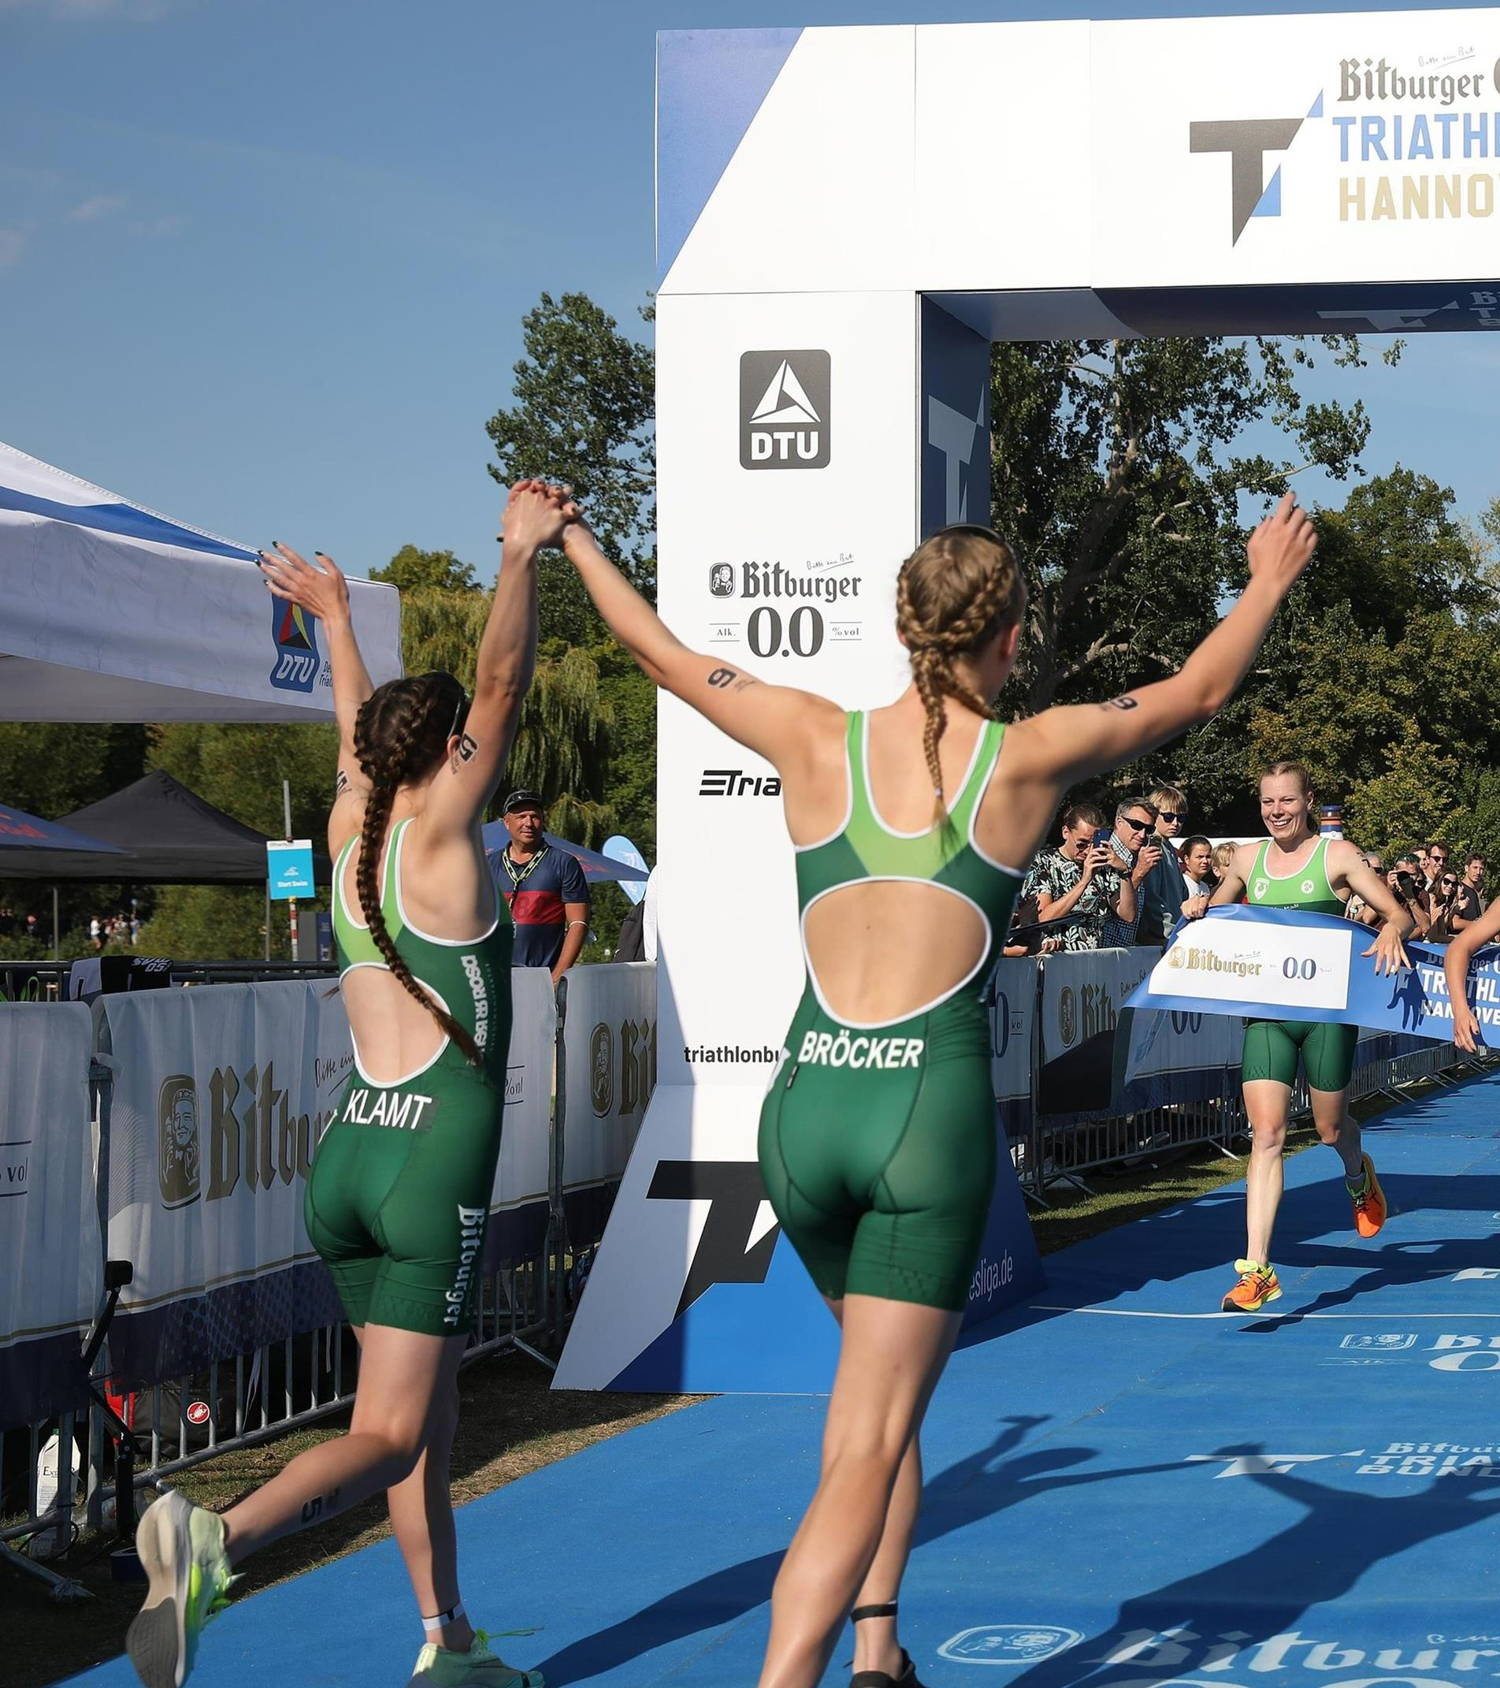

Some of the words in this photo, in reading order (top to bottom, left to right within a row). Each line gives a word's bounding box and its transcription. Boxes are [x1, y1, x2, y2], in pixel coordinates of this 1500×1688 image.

[1337, 58, 1485, 105] Bitburger
[751, 431, 819, 460] DTU
[740, 561, 862, 603] Bitburger
[747, 606, 824, 658] 0.0
[276, 653, 315, 684] DTU
[1187, 946, 1262, 977] Bitburger
[1282, 957, 1317, 981] 0.0
[798, 1030, 924, 1069] BRÖCKER
[342, 1089, 432, 1130] KLAMT
[443, 1203, 485, 1327] Bitburger
